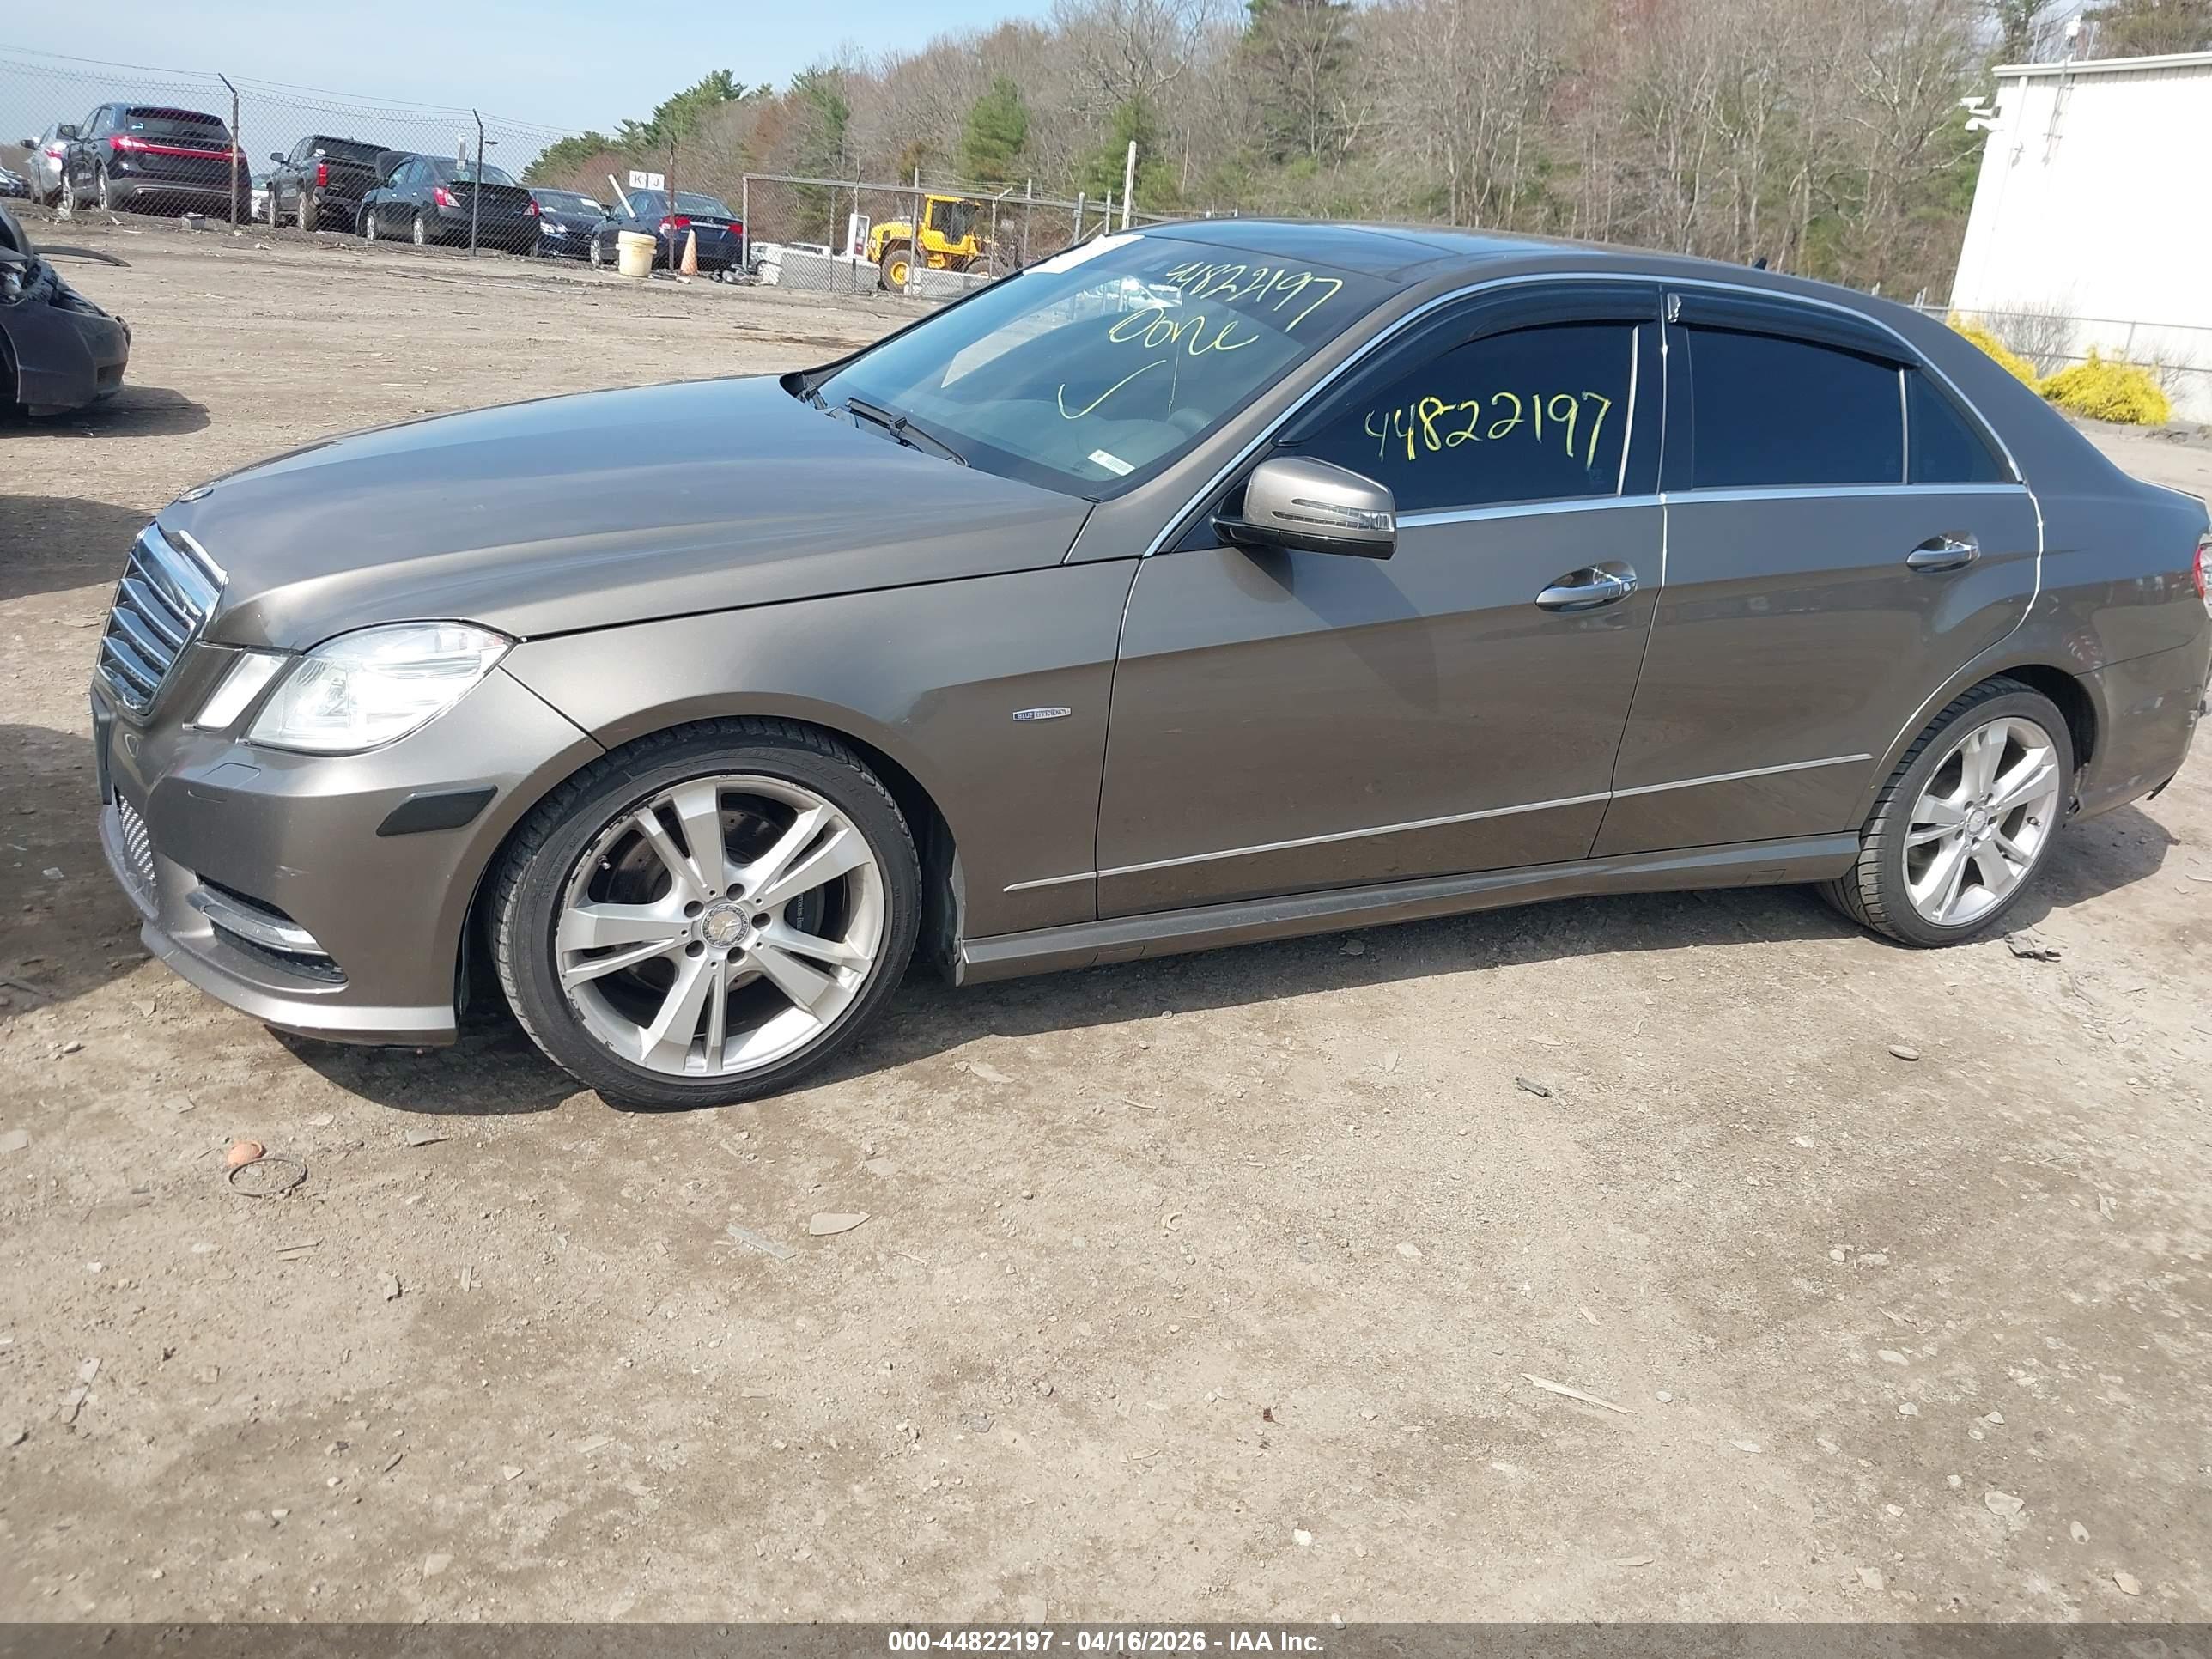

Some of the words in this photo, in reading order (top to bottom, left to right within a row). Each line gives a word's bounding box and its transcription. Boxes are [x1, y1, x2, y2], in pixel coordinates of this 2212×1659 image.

[634, 174, 642, 185] K
[653, 178, 659, 187] J
[1165, 260, 1345, 334] 44822197
[1364, 390, 1613, 471] 44822197
